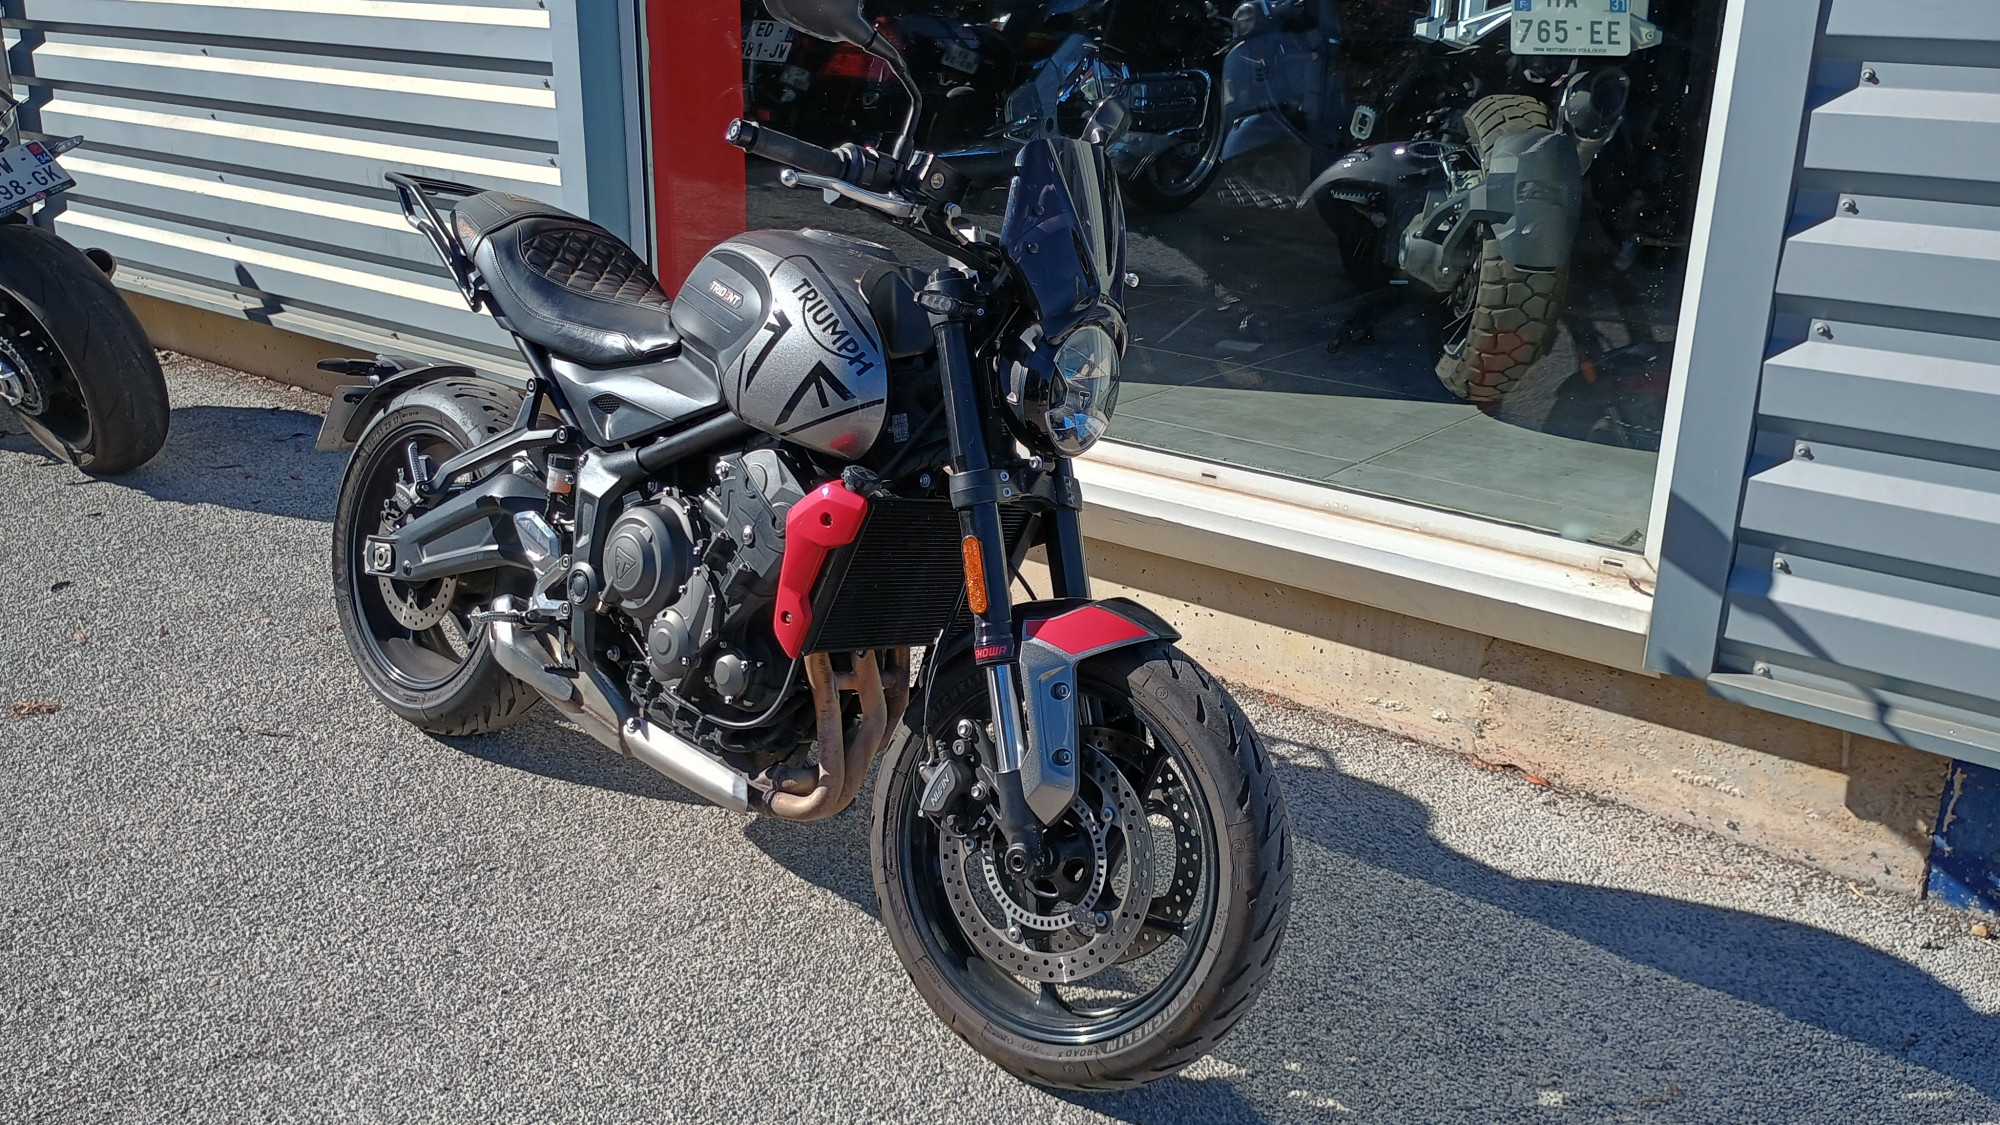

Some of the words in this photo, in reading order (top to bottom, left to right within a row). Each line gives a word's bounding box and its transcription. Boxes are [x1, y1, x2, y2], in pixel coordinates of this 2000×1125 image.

[1612, 0, 1626, 11] 31
[36, 152, 51, 163] 34
[0, 165, 62, 203] 98-GK
[709, 281, 741, 305] TRIDENT
[791, 278, 875, 377] TRIUMPH
[974, 645, 1007, 660] SHOWA
[930, 773, 950, 807] NISSIN
[1104, 999, 1180, 1053] MICHELIN
[1065, 1048, 1093, 1057] ROAD
